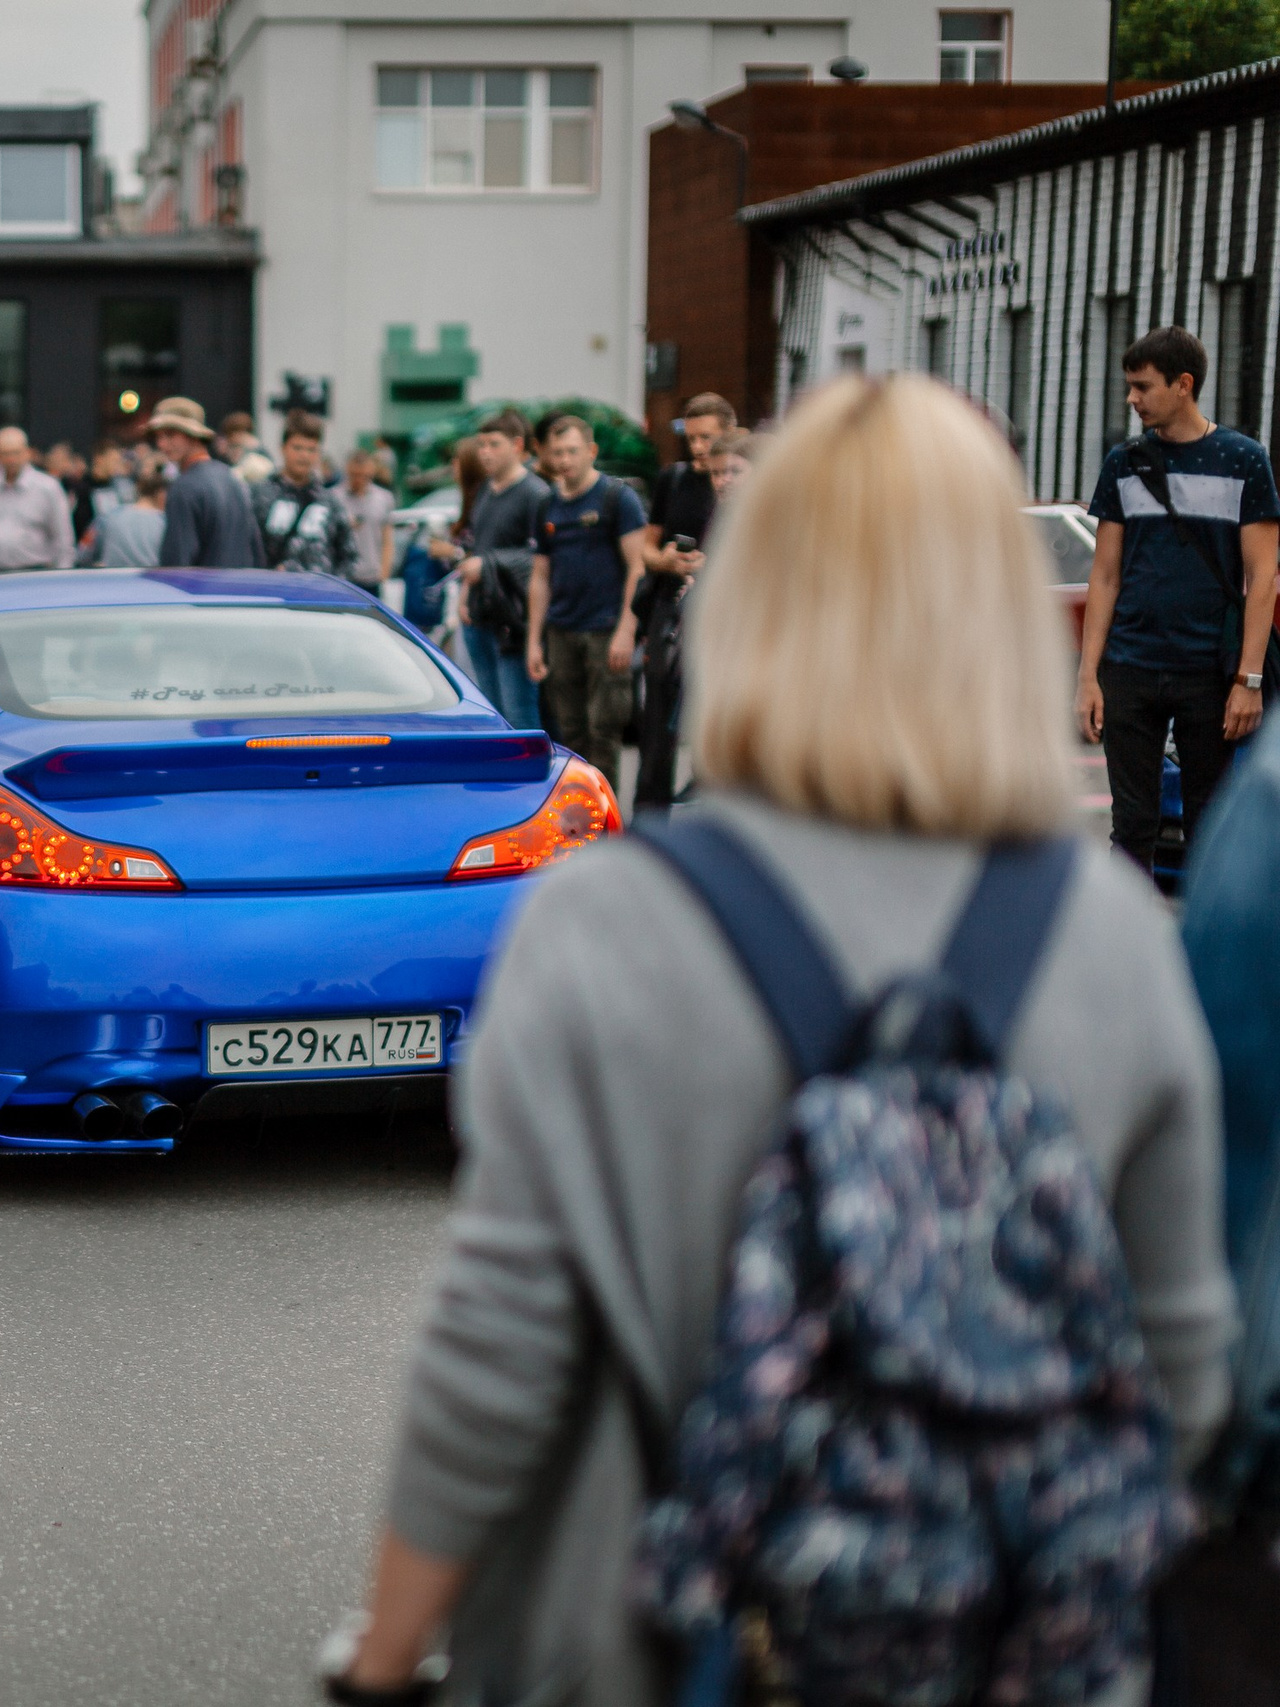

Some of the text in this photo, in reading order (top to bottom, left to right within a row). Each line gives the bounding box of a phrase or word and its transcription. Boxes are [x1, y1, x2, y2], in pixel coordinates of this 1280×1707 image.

[213, 684, 258, 696] and
[264, 683, 336, 697] Paint
[377, 1019, 432, 1050] 777
[388, 1048, 415, 1060] RUS
